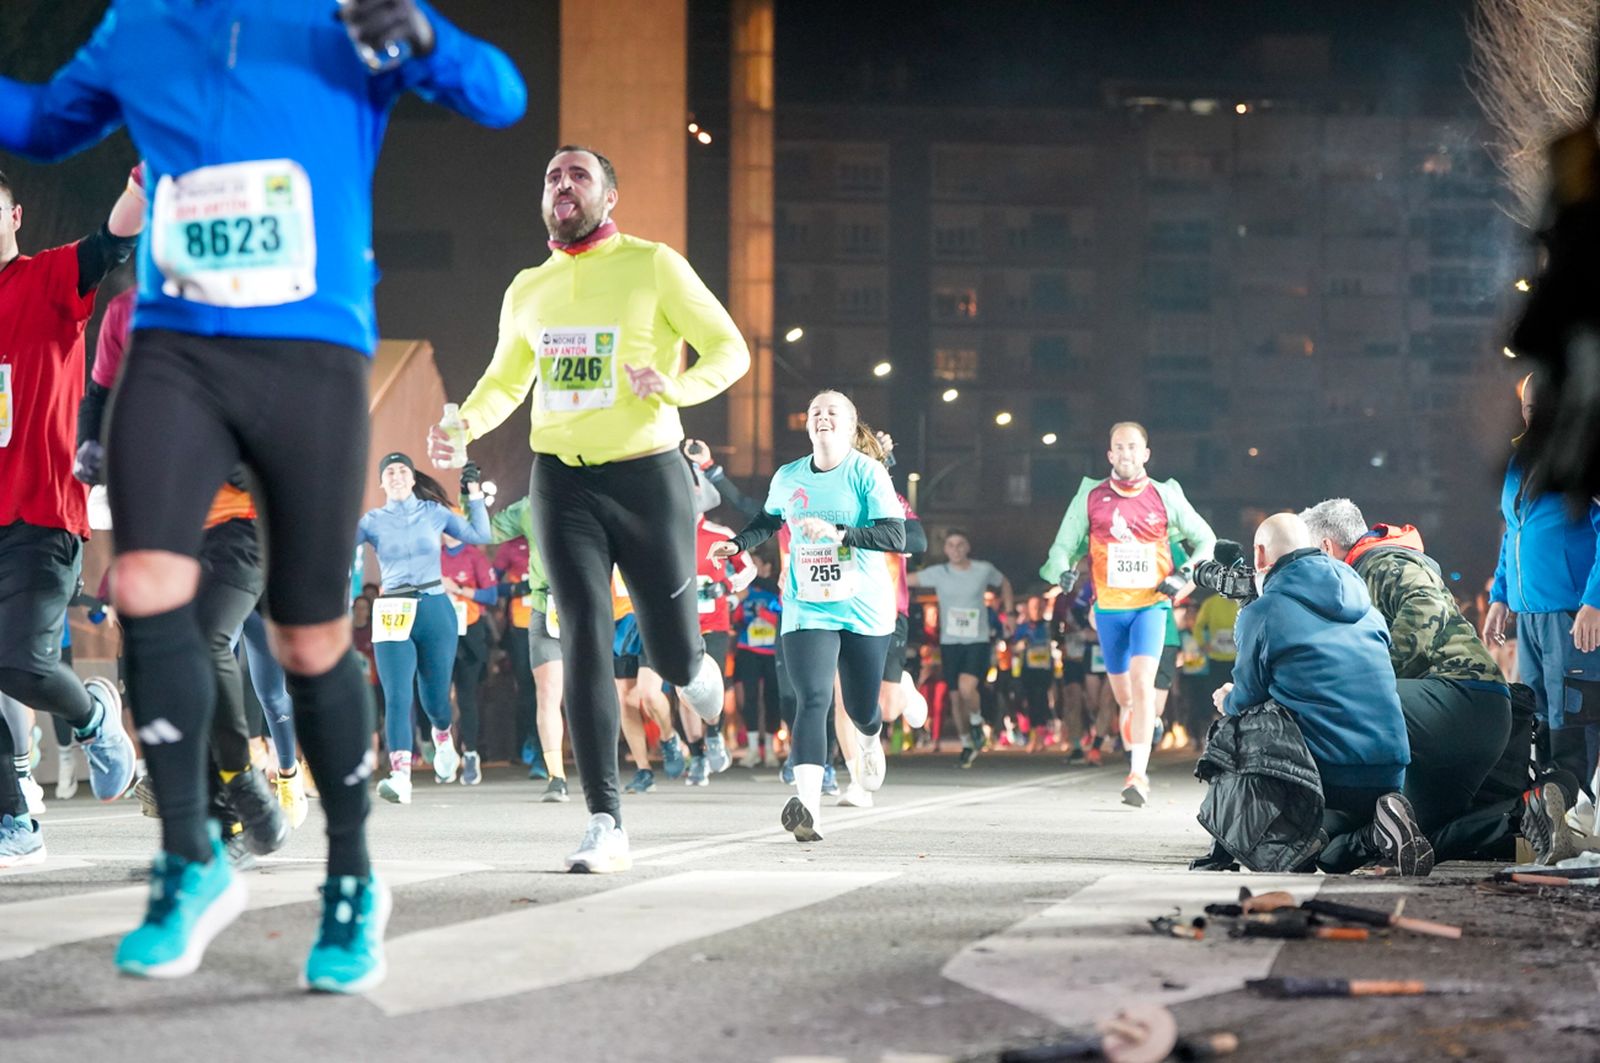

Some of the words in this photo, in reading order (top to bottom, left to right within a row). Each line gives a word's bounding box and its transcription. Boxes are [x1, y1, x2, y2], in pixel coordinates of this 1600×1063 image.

[185, 215, 282, 257] 8623
[553, 335, 575, 345] NOCHE
[577, 336, 587, 345] DE
[810, 564, 841, 582] 255
[1117, 560, 1149, 573] 3346
